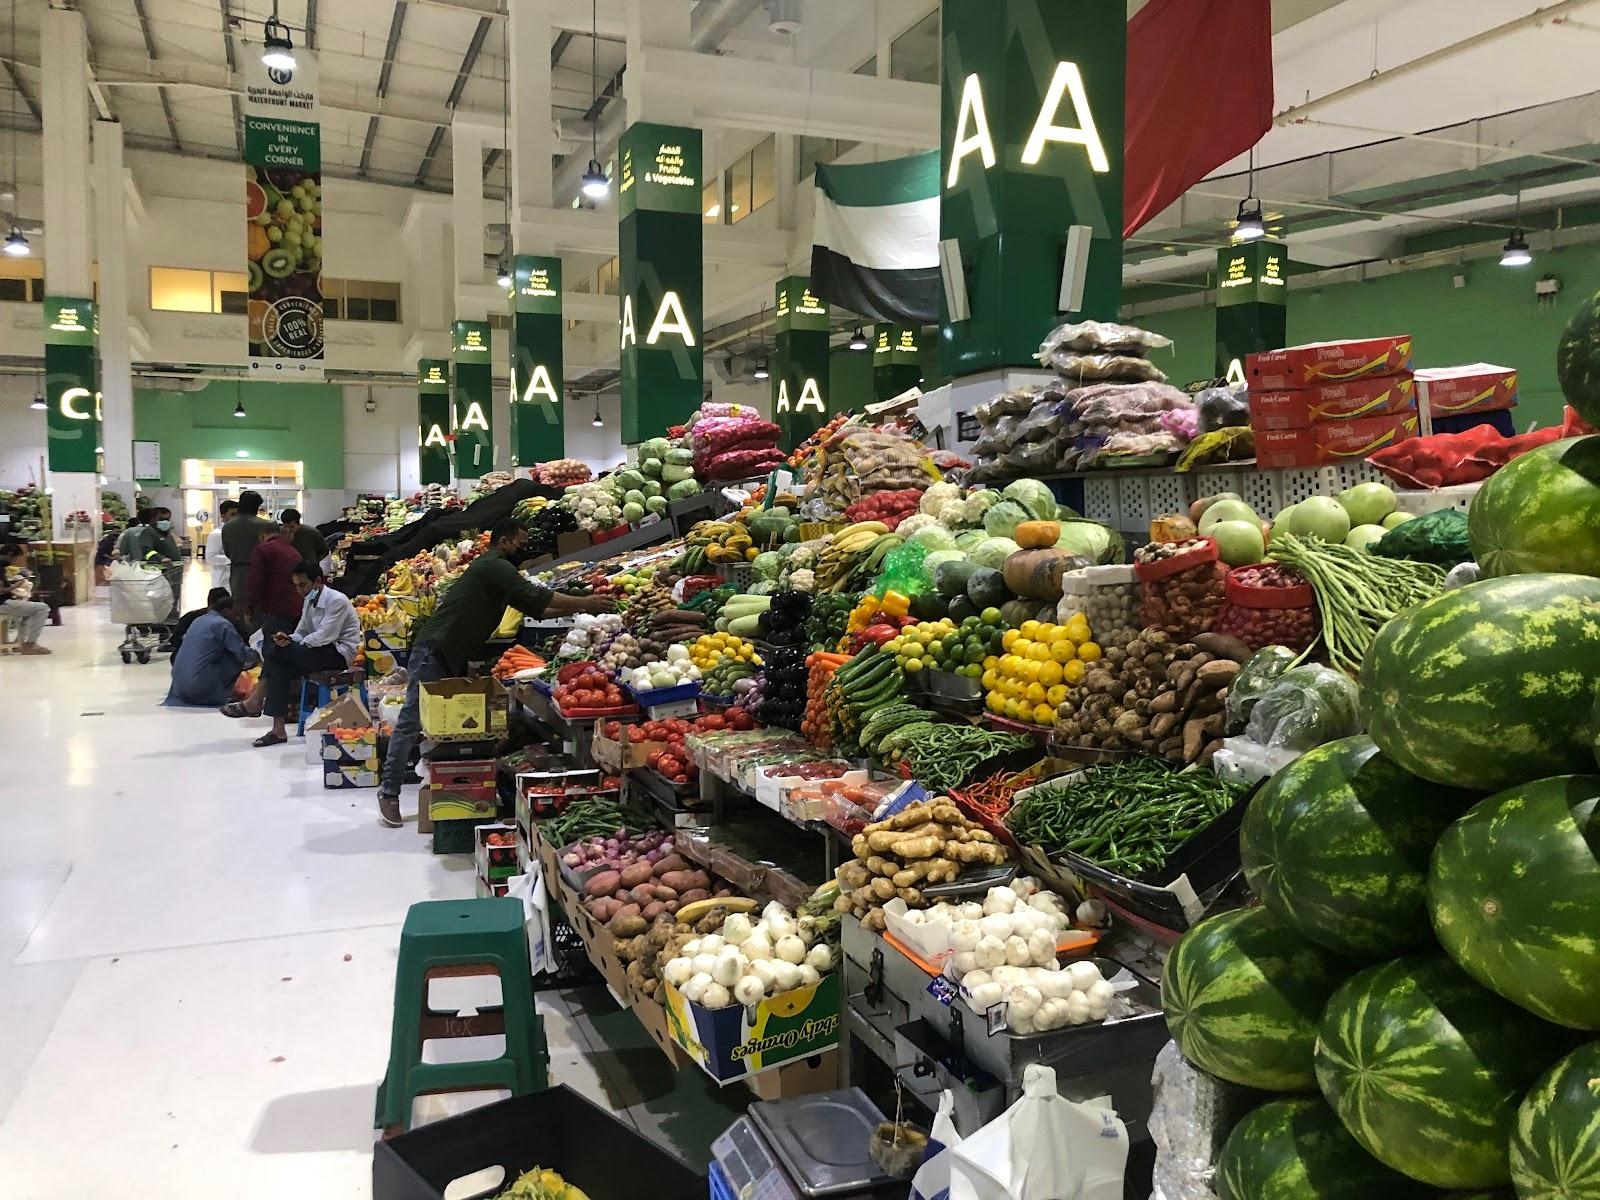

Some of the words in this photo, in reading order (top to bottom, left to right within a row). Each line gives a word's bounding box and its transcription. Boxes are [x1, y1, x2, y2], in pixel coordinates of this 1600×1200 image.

[248, 95, 287, 106] WATERFRONT
[289, 100, 314, 109] MARKET
[1020, 61, 1110, 173] A
[249, 121, 316, 136] CONVENIENCE
[947, 73, 996, 189] A
[278, 134, 289, 143] IN
[268, 144, 298, 154] EVERY
[265, 154, 304, 166] CORNER
[652, 173, 695, 186] Vegetables
[283, 317, 307, 333] 100%
[621, 294, 636, 350] A
[646, 291, 696, 347] A
[288, 328, 308, 341] REAL
[1271, 353, 1287, 361] Carrot
[1318, 346, 1345, 360] Fresh
[1337, 356, 1368, 370] Carrot
[1226, 358, 1248, 392] A
[523, 365, 559, 402] A
[777, 379, 790, 414] A
[795, 377, 826, 413] A
[1273, 394, 1290, 402] Carrot
[1321, 385, 1347, 400] Fresh
[60, 387, 90, 420] C
[1338, 395, 1370, 409] Carrot
[461, 402, 489, 431] A
[425, 424, 446, 447] A
[1327, 425, 1353, 439] Fresh
[1347, 433, 1376, 447] Carrot
[731, 1029, 799, 1062] Oranges
